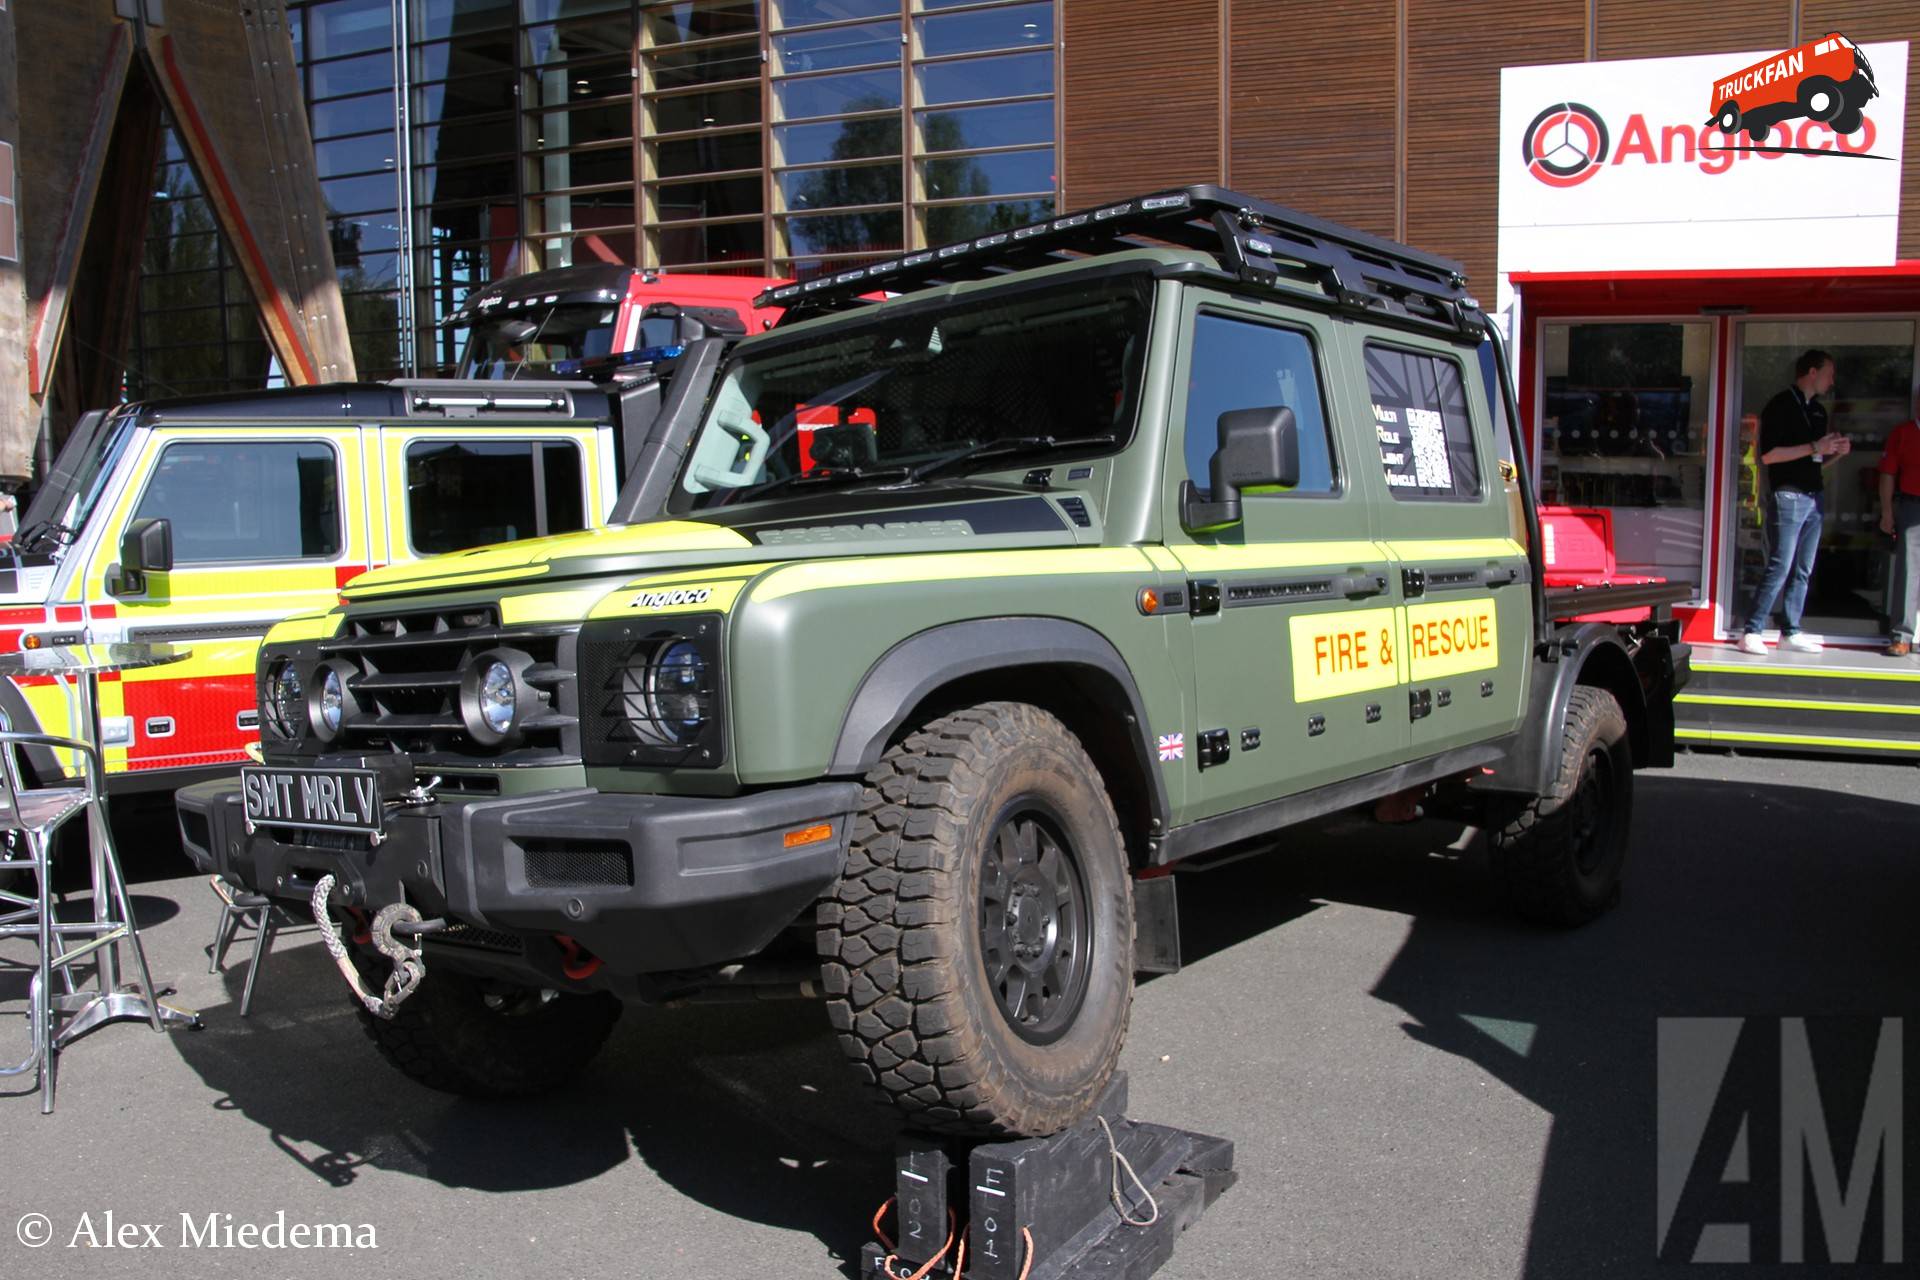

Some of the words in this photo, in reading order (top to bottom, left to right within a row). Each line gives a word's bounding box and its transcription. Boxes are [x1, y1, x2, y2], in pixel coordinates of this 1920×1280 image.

[627, 588, 713, 611] Angloco
[1315, 631, 1369, 676] FIRE
[1380, 628, 1393, 665] &
[1412, 615, 1490, 659] RESCUE
[245, 774, 294, 819] SMT
[300, 775, 374, 824] MRLV
